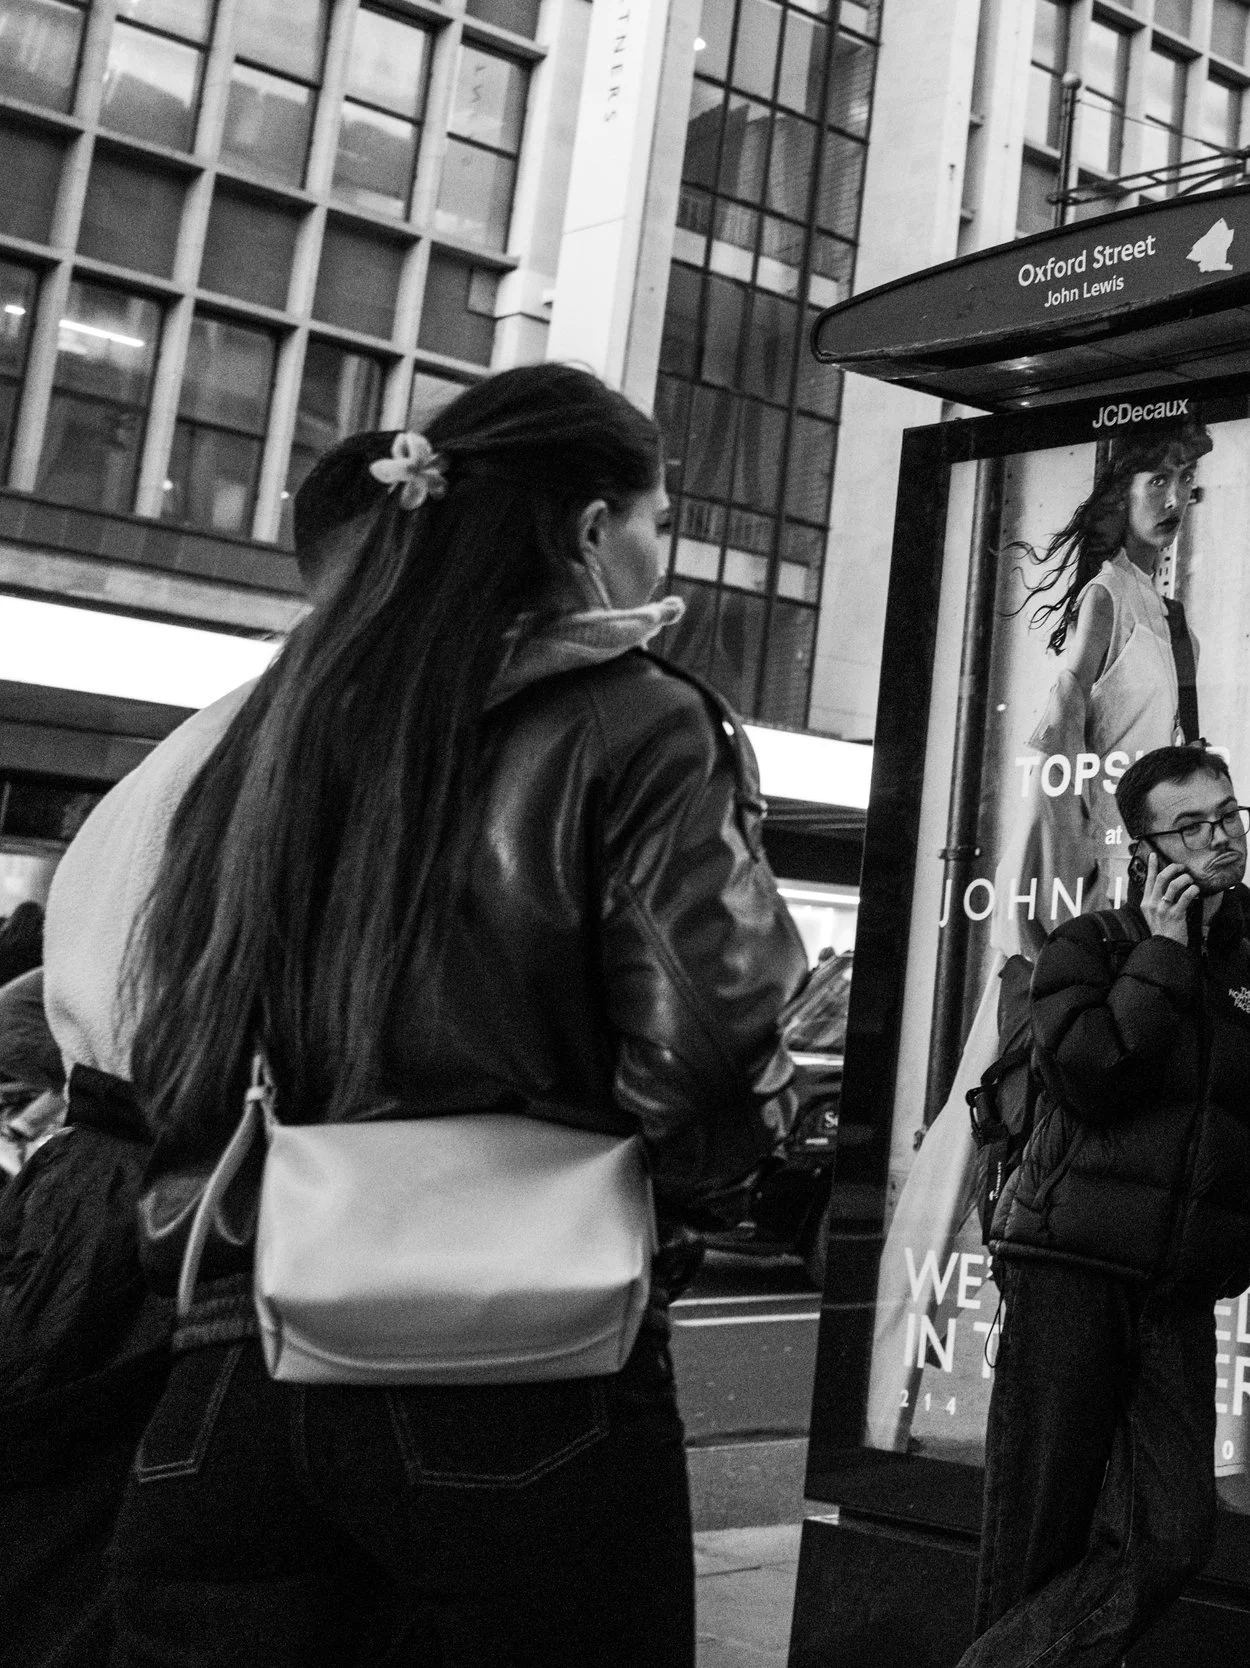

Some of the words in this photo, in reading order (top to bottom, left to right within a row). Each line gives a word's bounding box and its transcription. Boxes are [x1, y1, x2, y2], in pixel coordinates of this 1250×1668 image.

[1018, 249, 1087, 287] Oxford
[1092, 235, 1156, 269] Street
[1044, 286, 1079, 308] John
[1083, 275, 1125, 299] Lewis
[1092, 398, 1190, 429] JCDecaux
[1015, 746, 1231, 798] TOPS
[1105, 825, 1123, 845] at
[939, 876, 1084, 927] JOHN
[903, 1312, 957, 1373] IN
